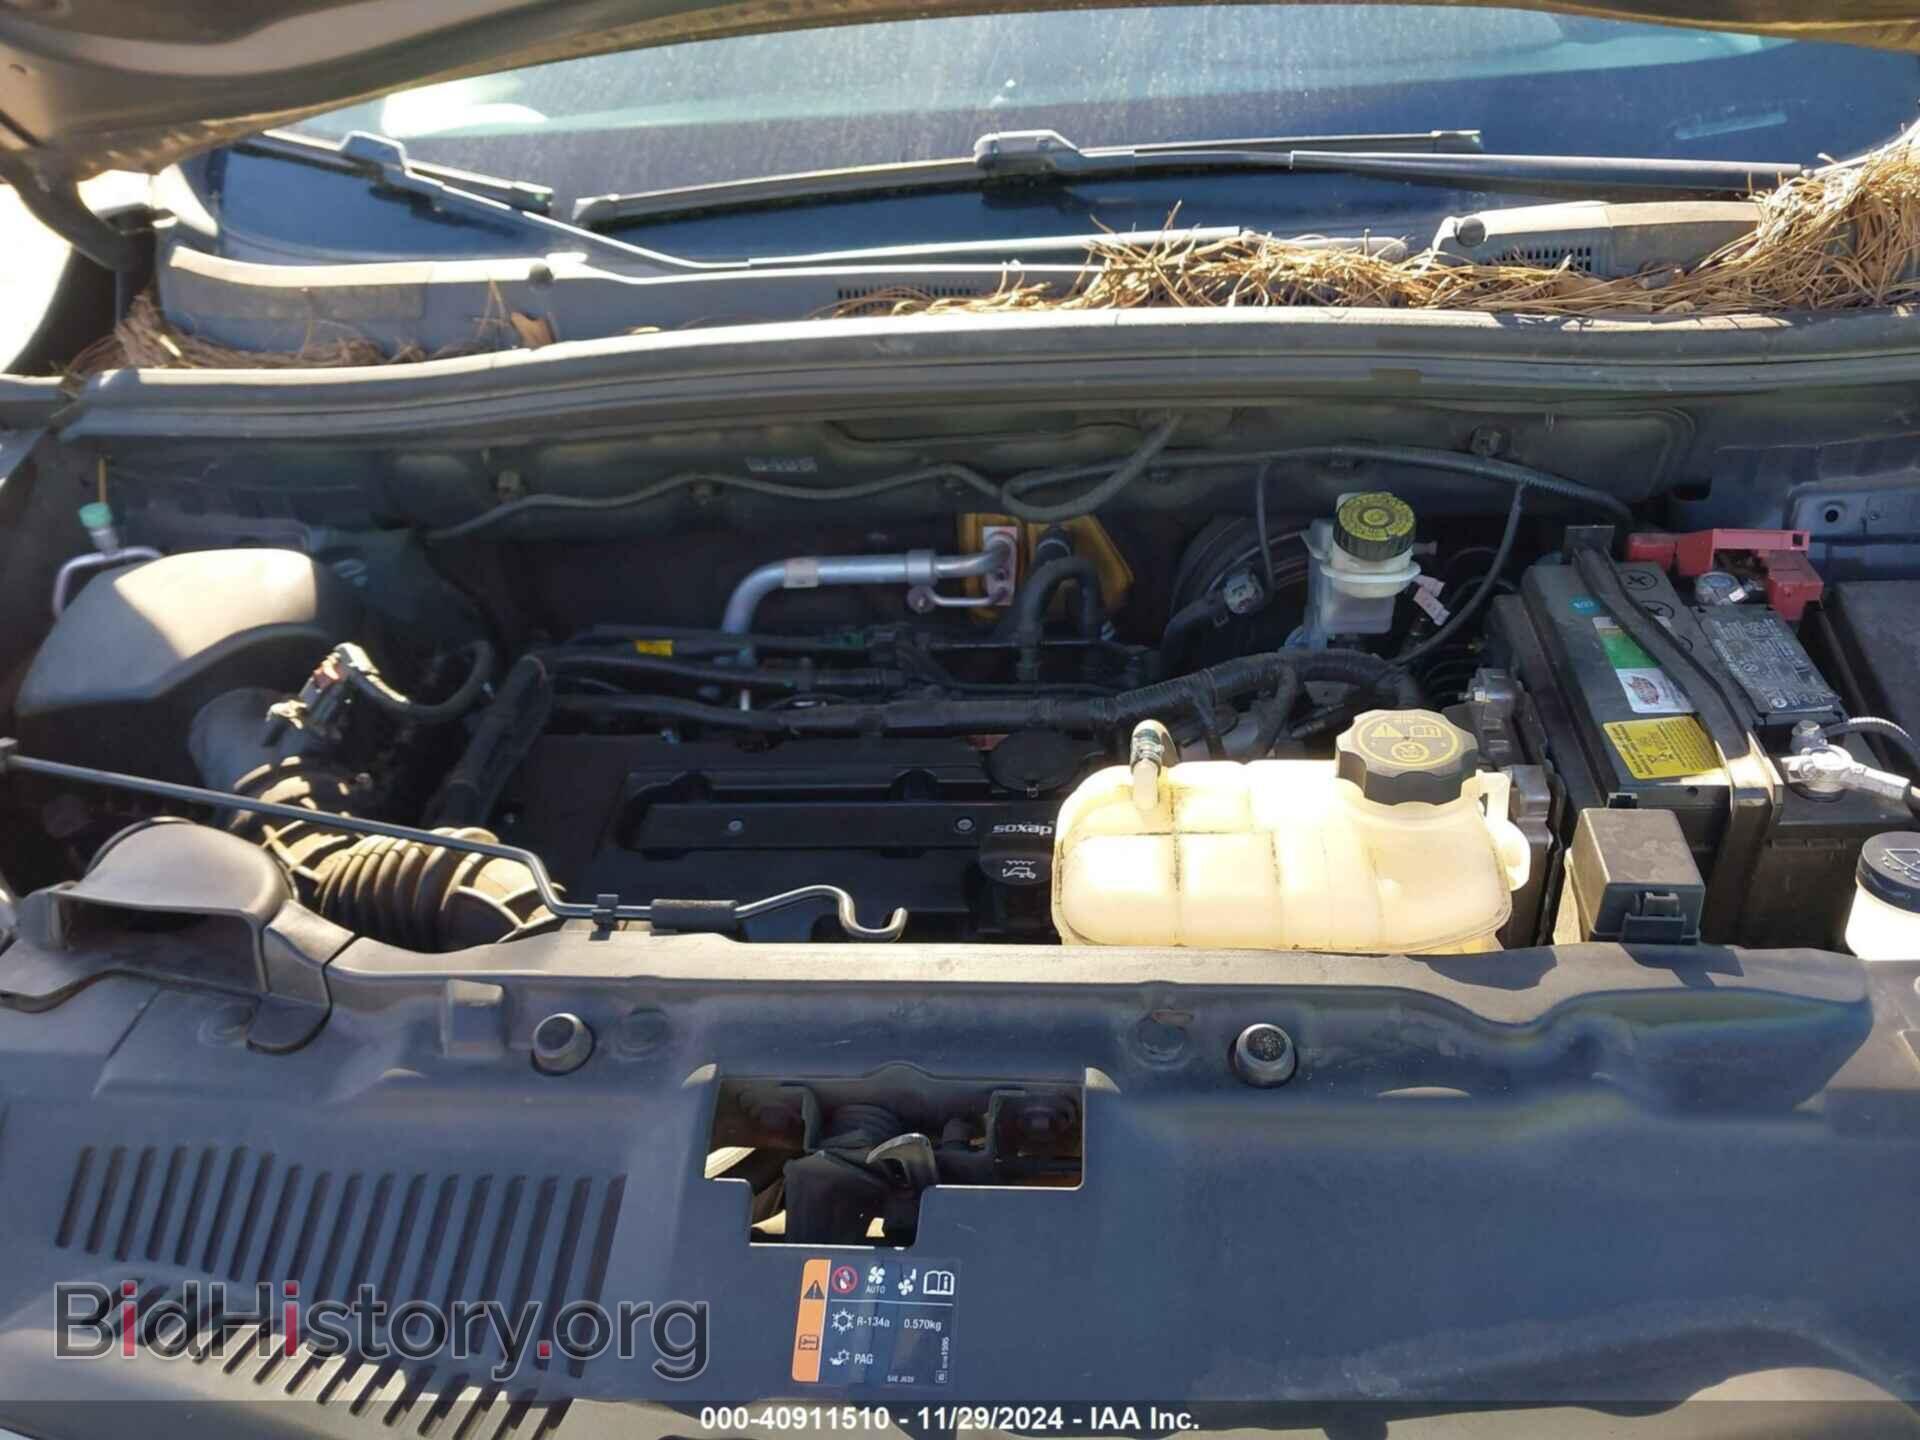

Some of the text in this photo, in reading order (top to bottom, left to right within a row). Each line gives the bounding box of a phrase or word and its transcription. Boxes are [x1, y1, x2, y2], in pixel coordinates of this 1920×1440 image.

[992, 824, 1053, 836] dexos
[865, 1285, 886, 1295] AUTO
[856, 1316, 942, 1332] R-134a 0.570kg
[854, 1353, 874, 1365] PAG
